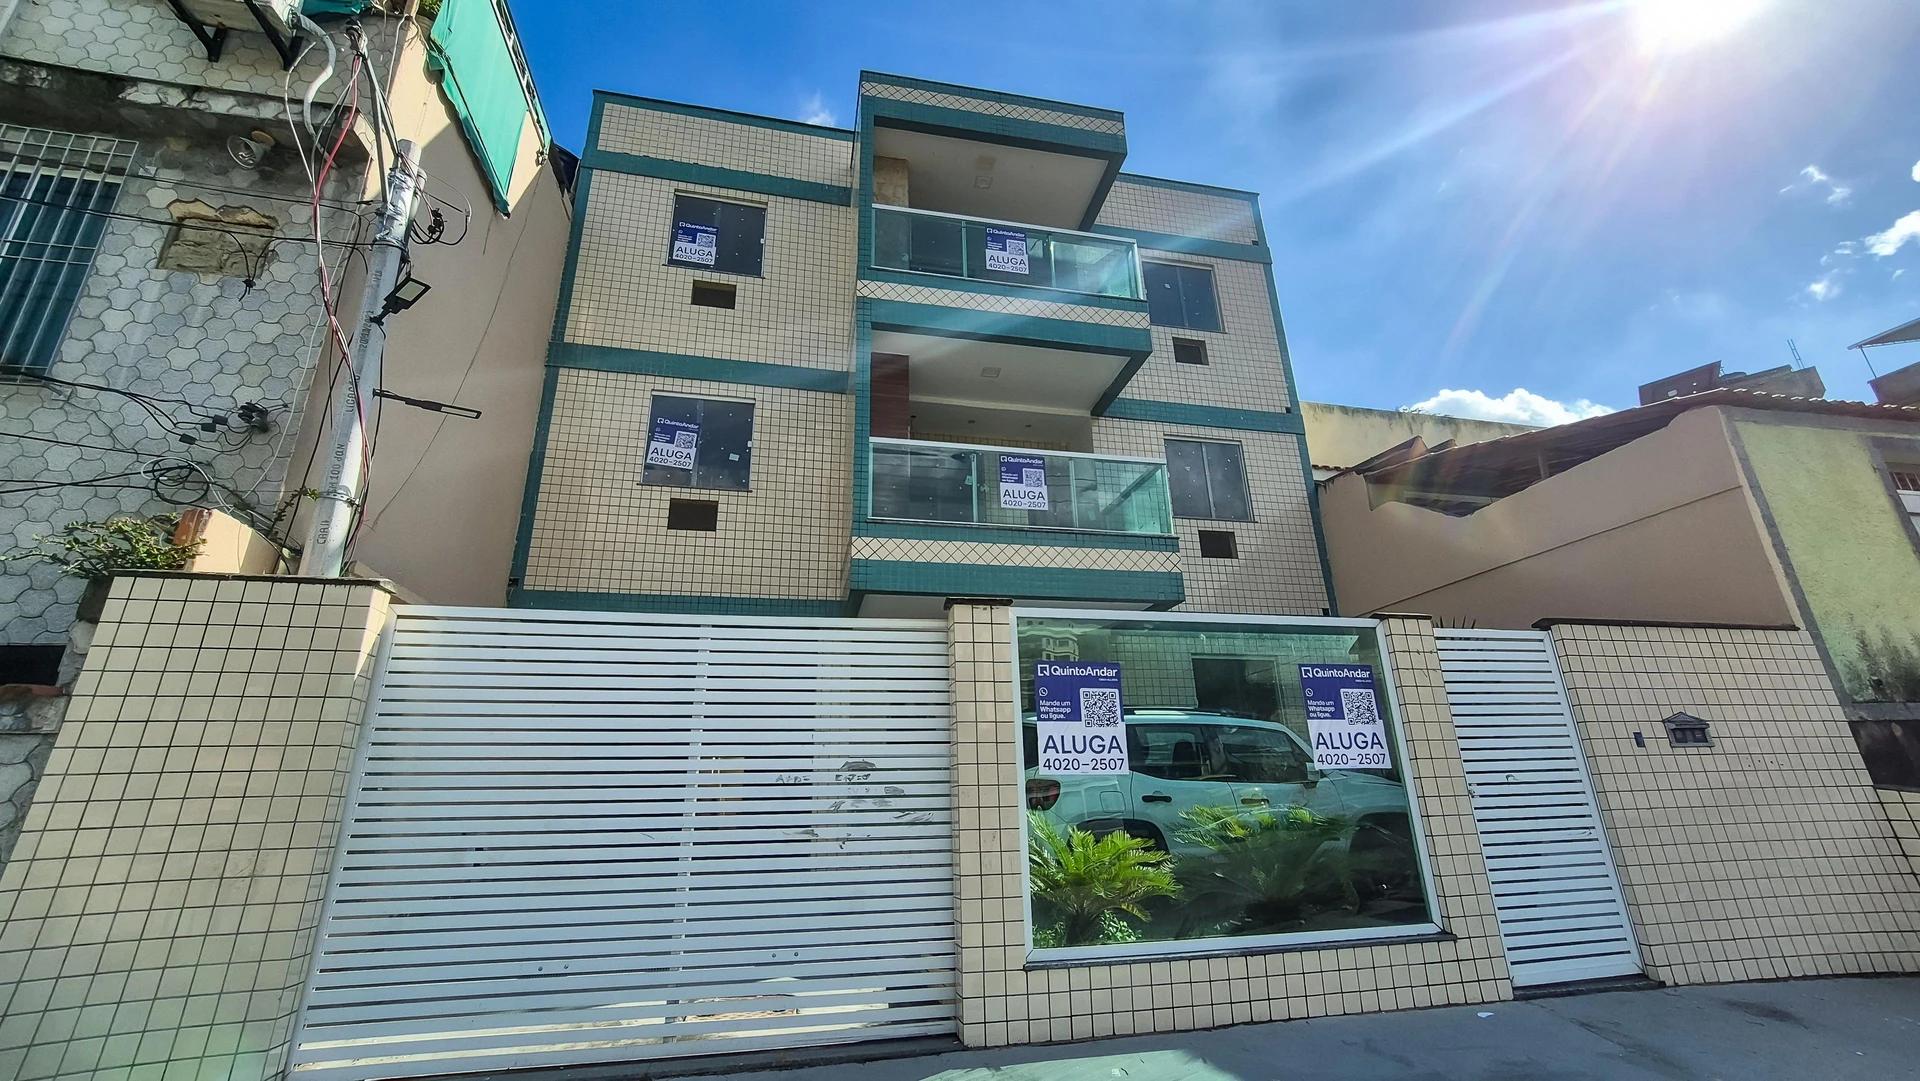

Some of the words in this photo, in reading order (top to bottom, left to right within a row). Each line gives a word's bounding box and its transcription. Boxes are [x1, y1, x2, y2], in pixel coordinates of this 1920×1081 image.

[676, 246, 713, 257] ALUGA
[675, 254, 713, 263] 4020-2507
[989, 255, 1026, 266] ALUGA
[989, 263, 1027, 272] 4020-2507
[665, 419, 699, 429] QuintoAndar
[651, 447, 692, 460] ALUGA
[649, 457, 691, 467] 4020-2507
[330, 464, 340, 480] 100
[1003, 489, 1045, 500] ALUGA
[1003, 500, 1046, 508] 4020-2507
[1051, 666, 1117, 677] QuintoAndar
[1314, 668, 1370, 678] QuintoAndar
[1043, 735, 1123, 754] ALUGA
[1316, 732, 1384, 750] ALUGA
[1043, 758, 1124, 771] 4020-2507
[1317, 754, 1385, 765] 4020-2507
